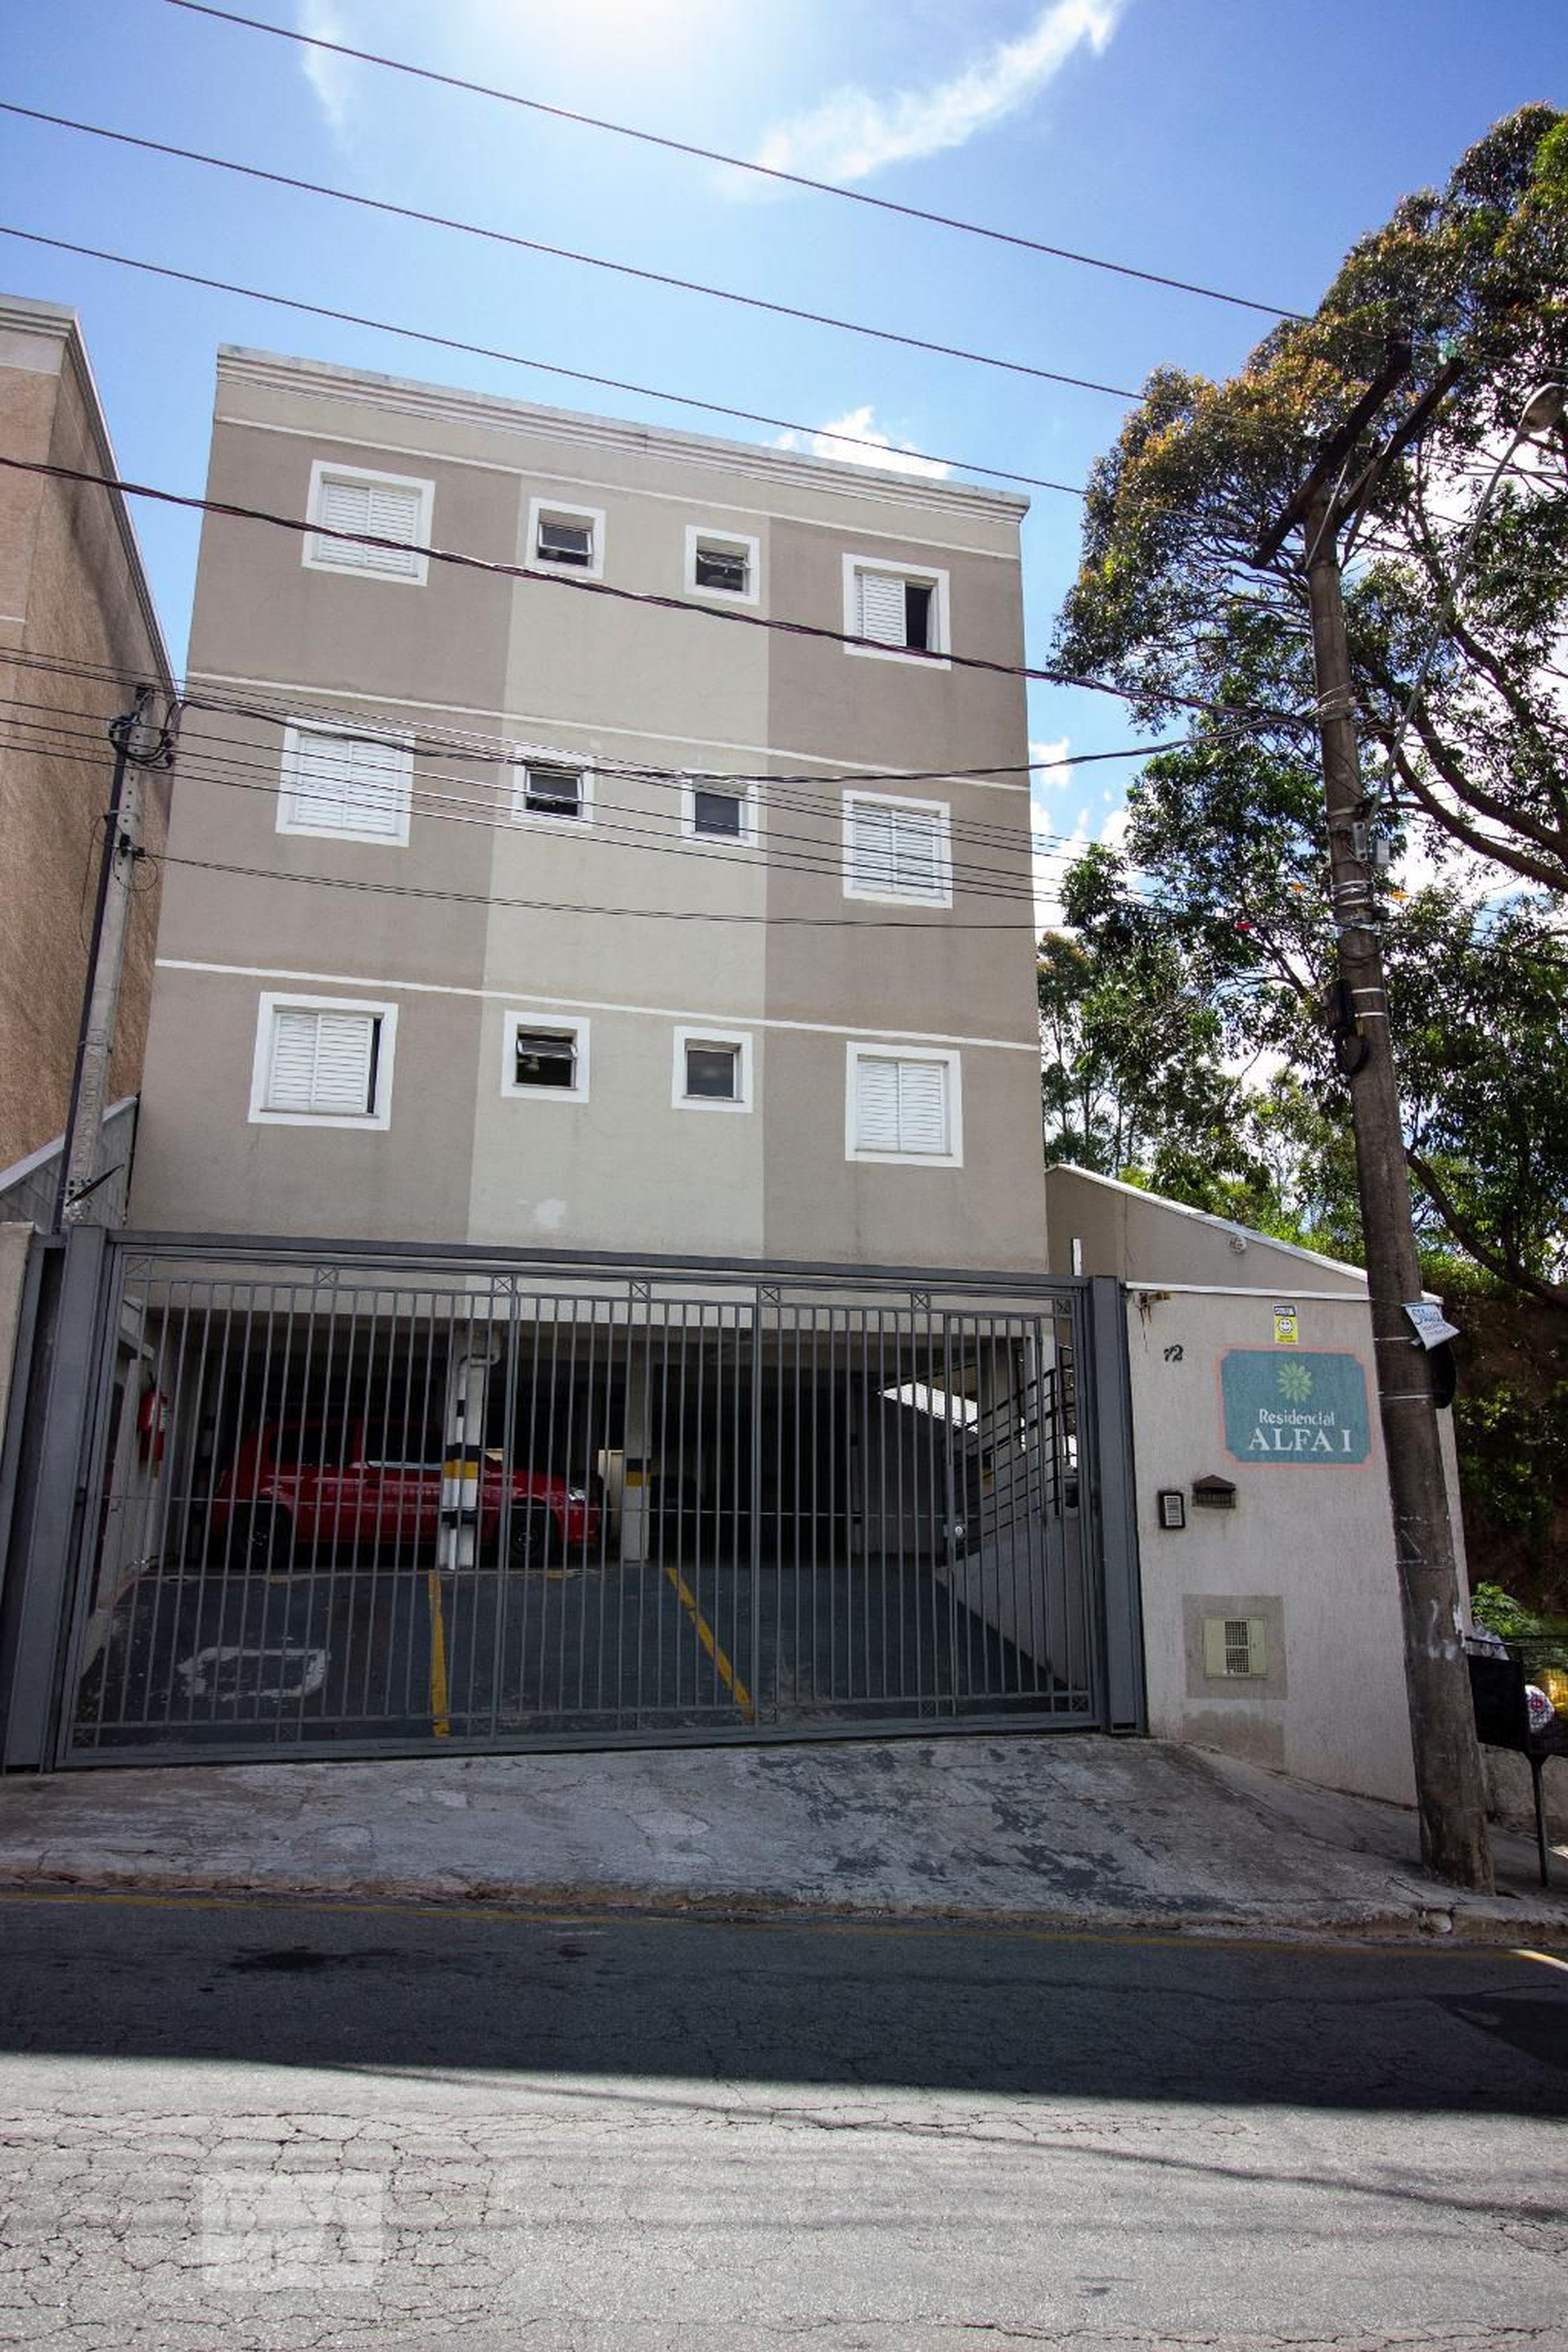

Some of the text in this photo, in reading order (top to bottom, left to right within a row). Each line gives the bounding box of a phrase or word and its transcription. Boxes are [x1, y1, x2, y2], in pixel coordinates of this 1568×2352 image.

[1163, 1344, 1184, 1363] 72
[1259, 1408, 1335, 1426] Residencial
[1248, 1428, 1333, 1452] ALFA
